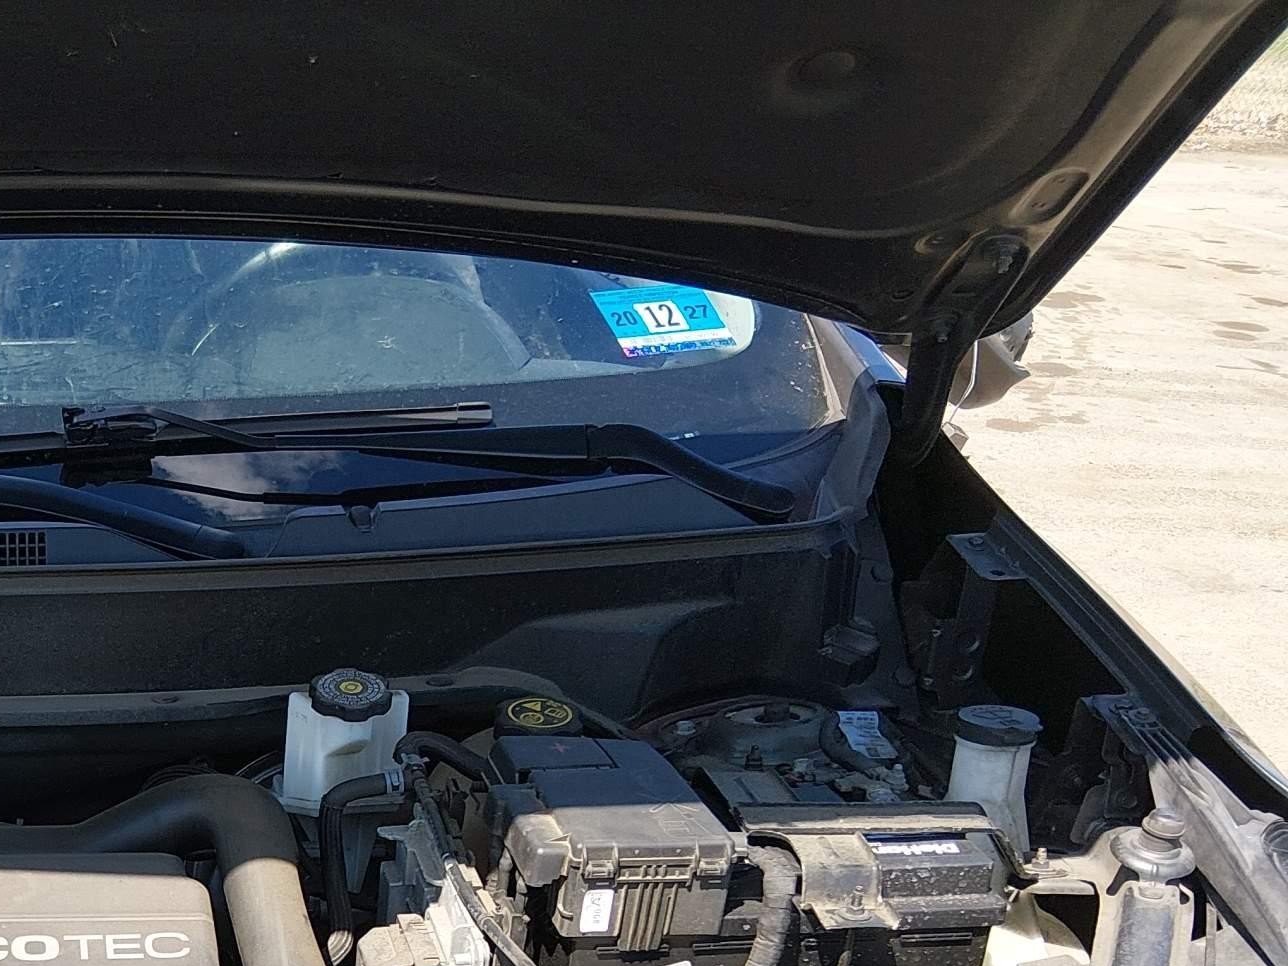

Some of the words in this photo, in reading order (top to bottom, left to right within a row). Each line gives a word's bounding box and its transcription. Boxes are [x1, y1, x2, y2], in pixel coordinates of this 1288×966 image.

[611, 310, 637, 327] 20
[644, 303, 680, 328] 12
[683, 304, 708, 320] 27
